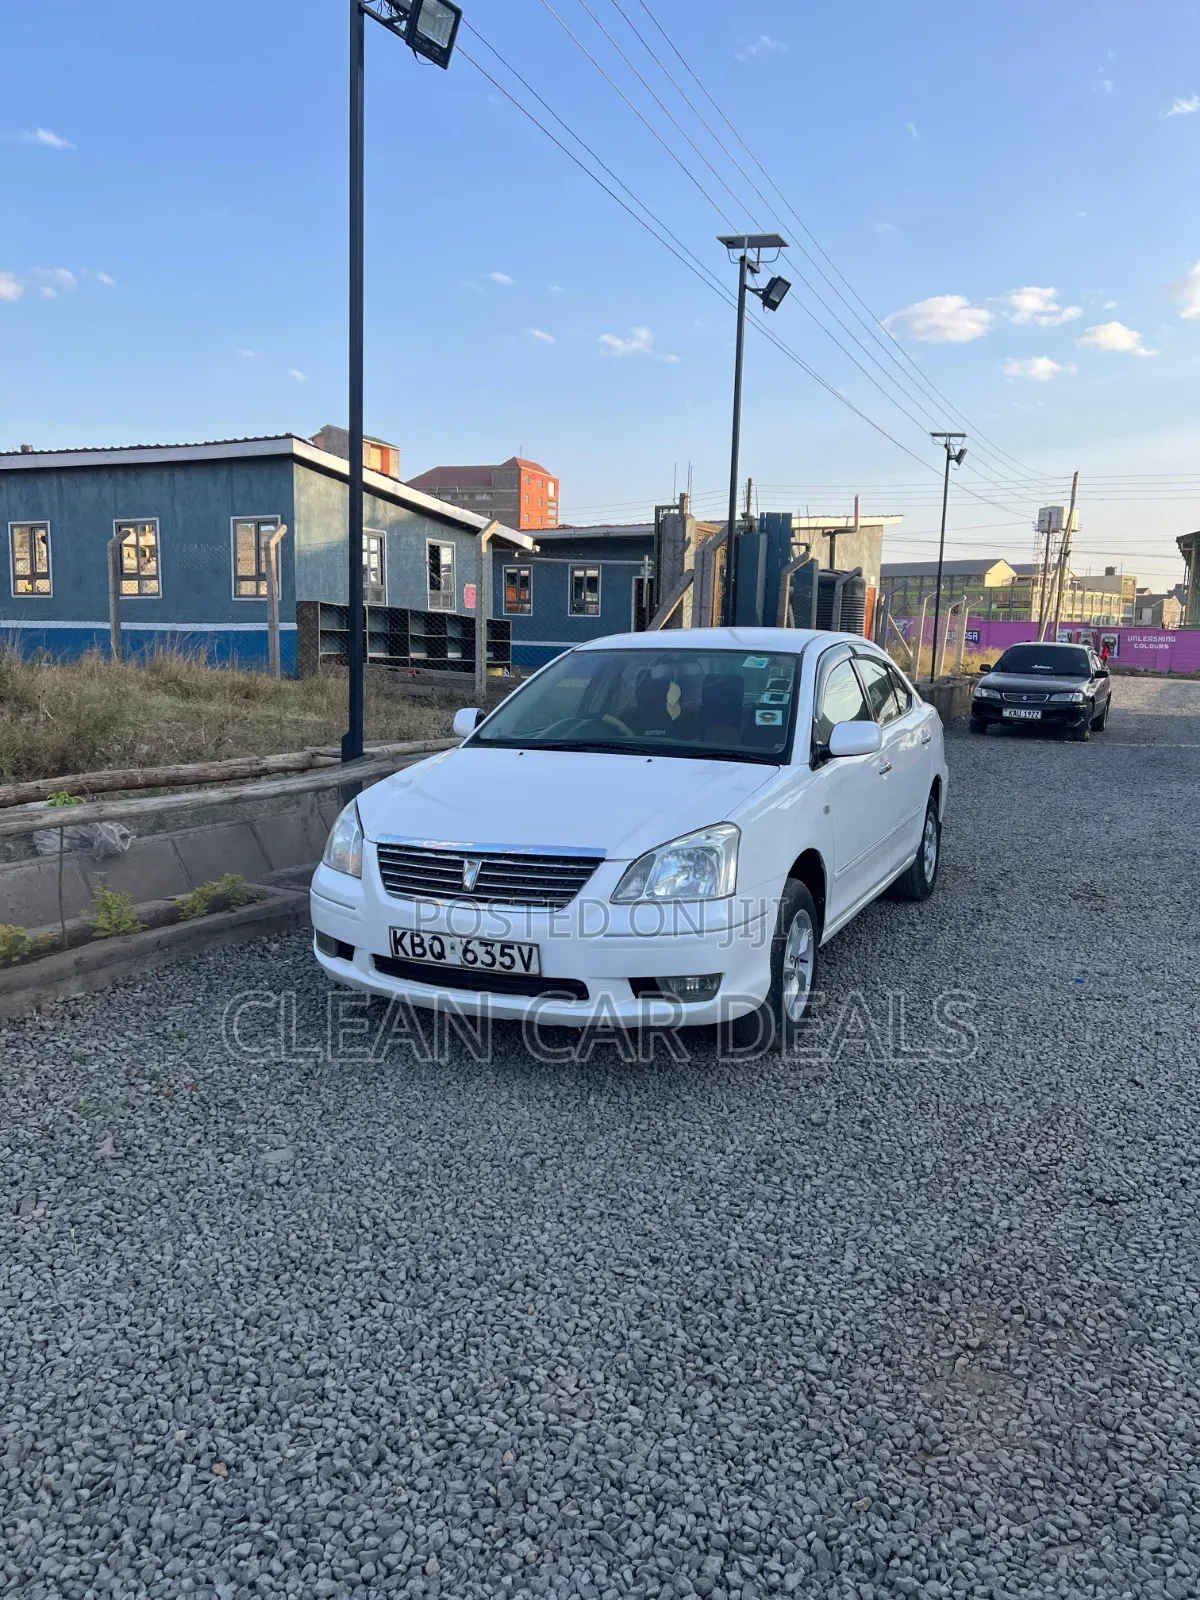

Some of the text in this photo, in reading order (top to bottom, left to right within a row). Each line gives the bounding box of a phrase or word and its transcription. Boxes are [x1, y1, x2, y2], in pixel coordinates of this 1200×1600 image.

[1127, 635, 1176, 643] UNLEASHING
[392, 929, 534, 973] KBQ 635V
